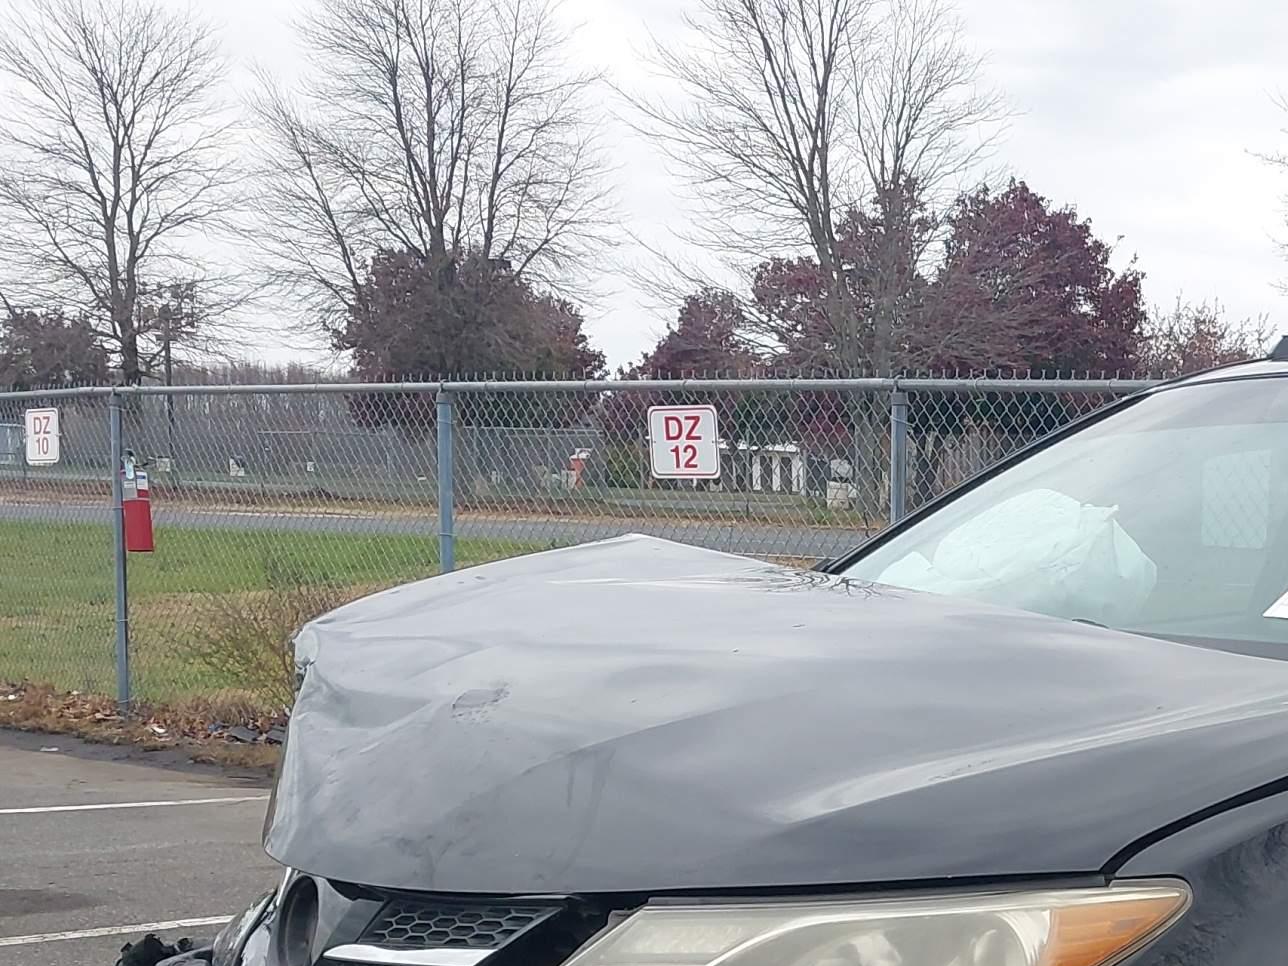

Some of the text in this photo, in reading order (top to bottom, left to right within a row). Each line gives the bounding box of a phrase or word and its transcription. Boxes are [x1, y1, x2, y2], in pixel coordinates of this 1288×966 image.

[33, 416, 51, 435] DZ
[664, 415, 702, 440] DZ
[36, 437, 49, 455] 10
[670, 445, 698, 469] 12
